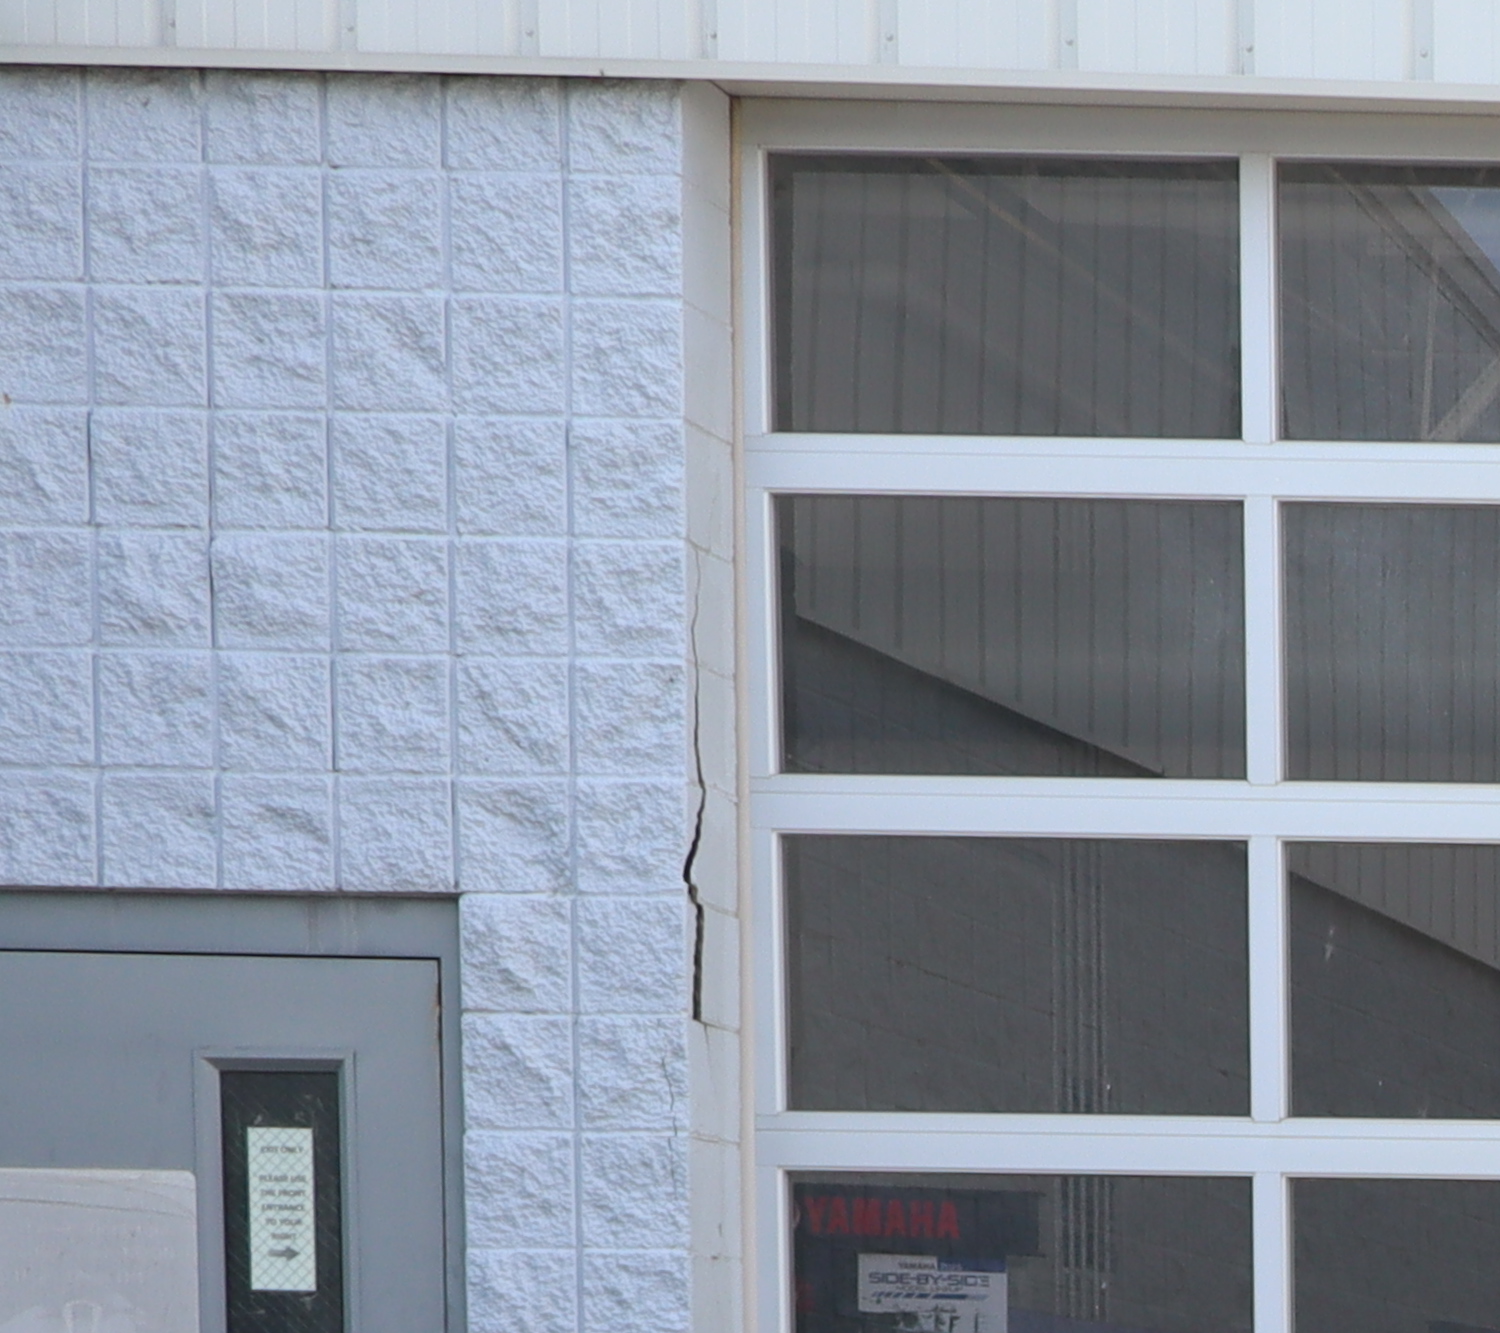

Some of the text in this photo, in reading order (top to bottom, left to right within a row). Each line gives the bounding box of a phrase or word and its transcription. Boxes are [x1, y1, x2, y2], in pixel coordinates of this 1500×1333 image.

[804, 1196, 961, 1239] YAMAHA
[898, 1262, 936, 1270] YAMAHA
[868, 1272, 990, 1288] SIDE-BY-SIDE
